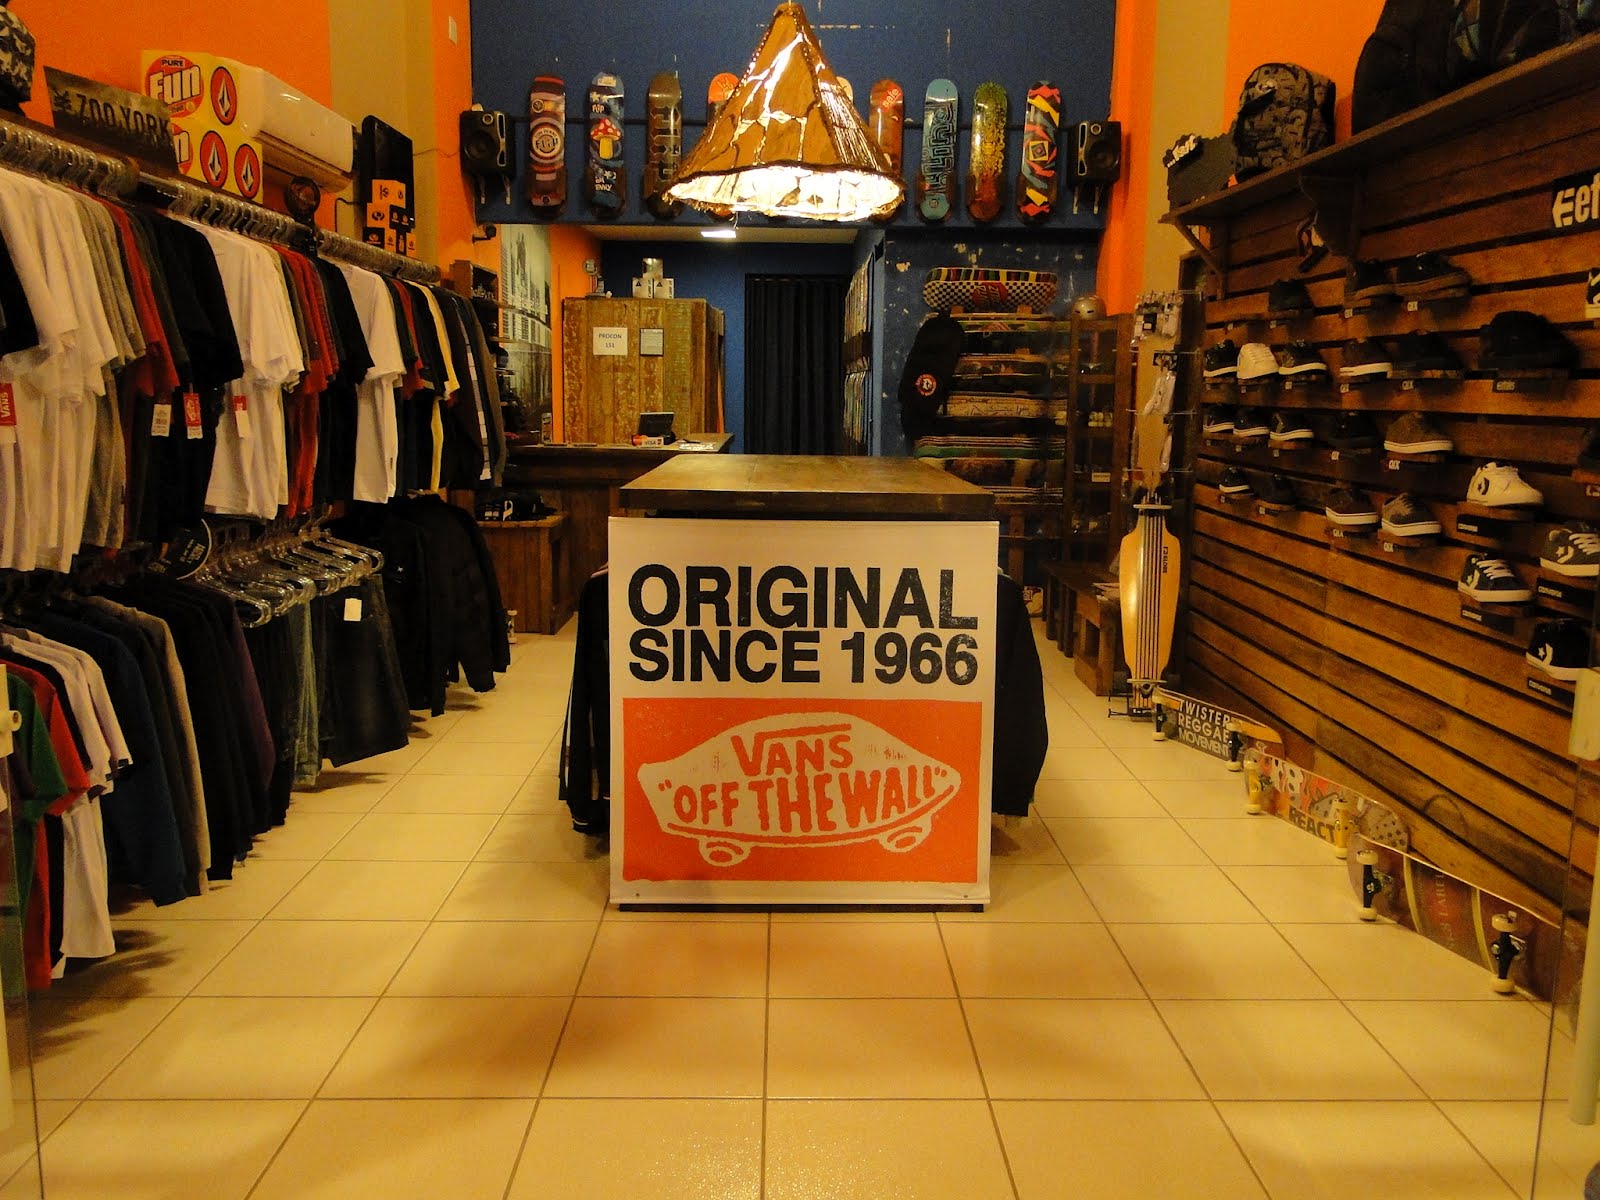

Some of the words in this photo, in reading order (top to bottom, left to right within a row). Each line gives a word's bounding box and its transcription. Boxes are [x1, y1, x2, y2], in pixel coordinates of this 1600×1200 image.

[161, 58, 184, 67] PURE
[882, 88, 900, 108] sale
[76, 93, 116, 128] ZOO
[121, 106, 171, 146] YORK
[0, 391, 10, 418] VANS
[628, 563, 978, 630] ORIGINAL
[629, 628, 820, 683] SINCE
[841, 631, 978, 685] 1966
[1178, 699, 1231, 728] TWISTER
[1178, 712, 1230, 744] REGGAE
[731, 723, 854, 777] VANS
[1178, 727, 1230, 758] MOVEMENT
[748, 771, 838, 833] THE
[1289, 804, 1336, 844] REACT
